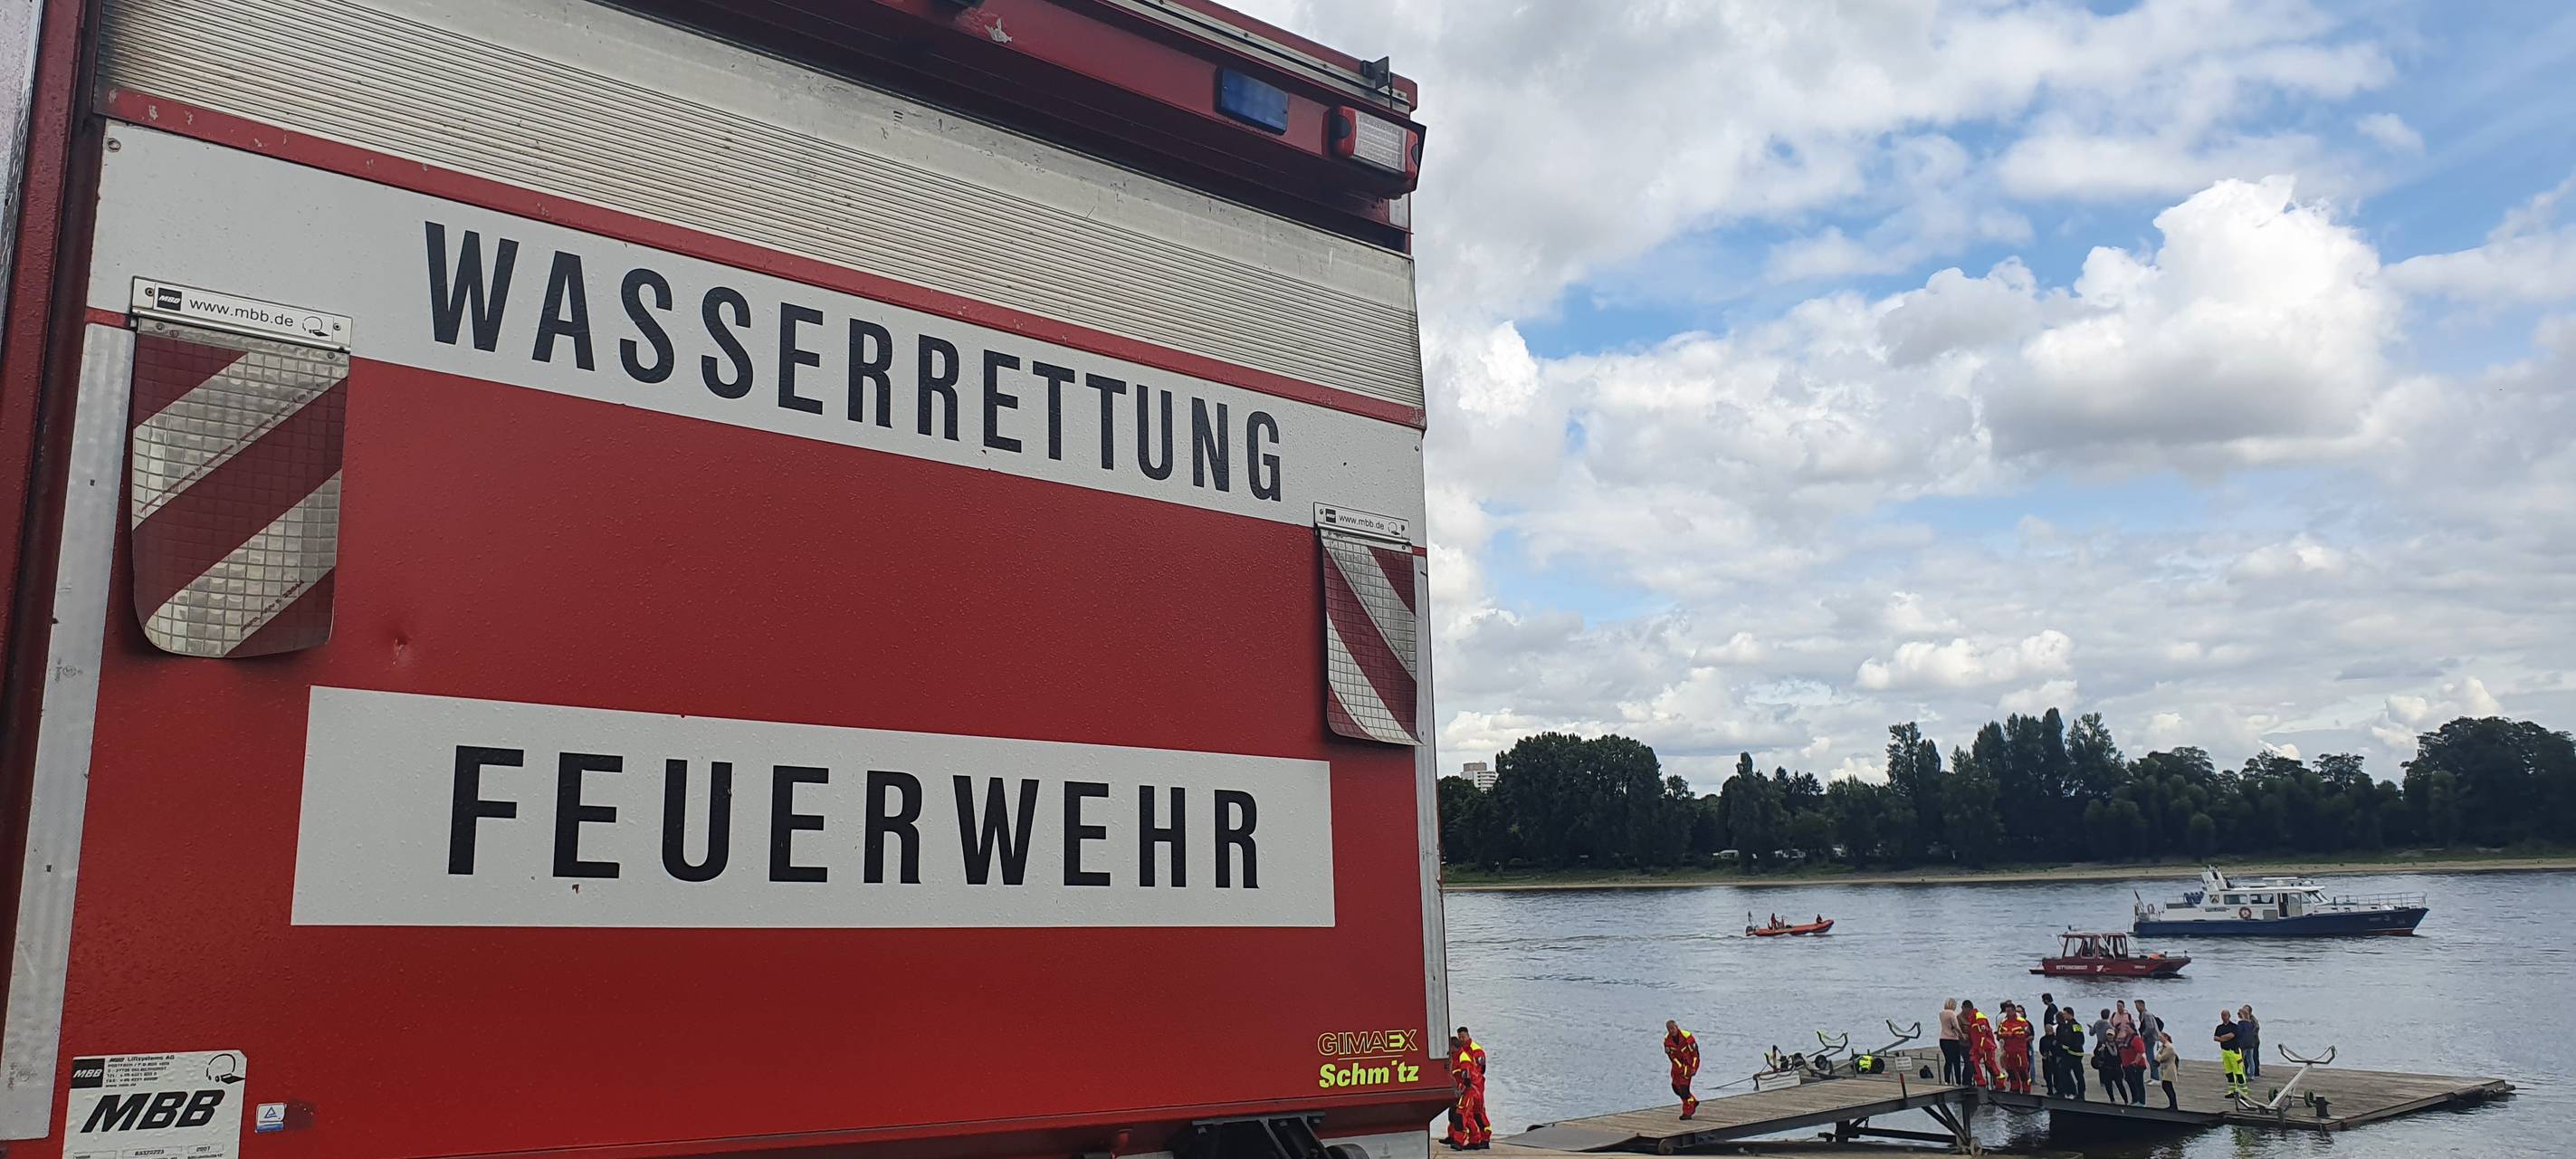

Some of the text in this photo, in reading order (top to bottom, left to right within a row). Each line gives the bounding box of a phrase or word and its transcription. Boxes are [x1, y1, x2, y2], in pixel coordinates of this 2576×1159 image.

[189, 298, 294, 327] www.mbb.de
[425, 221, 1283, 503] WASSERRETTUNG
[1338, 513, 1385, 531] www.mbb.de
[447, 744, 1261, 889] FEUERWEHR
[1317, 1029, 1418, 1056] GIMAEX
[72, 1068, 103, 1078] MBB
[1319, 1059, 1419, 1088] Schmtz
[80, 1089, 225, 1134] MBB
